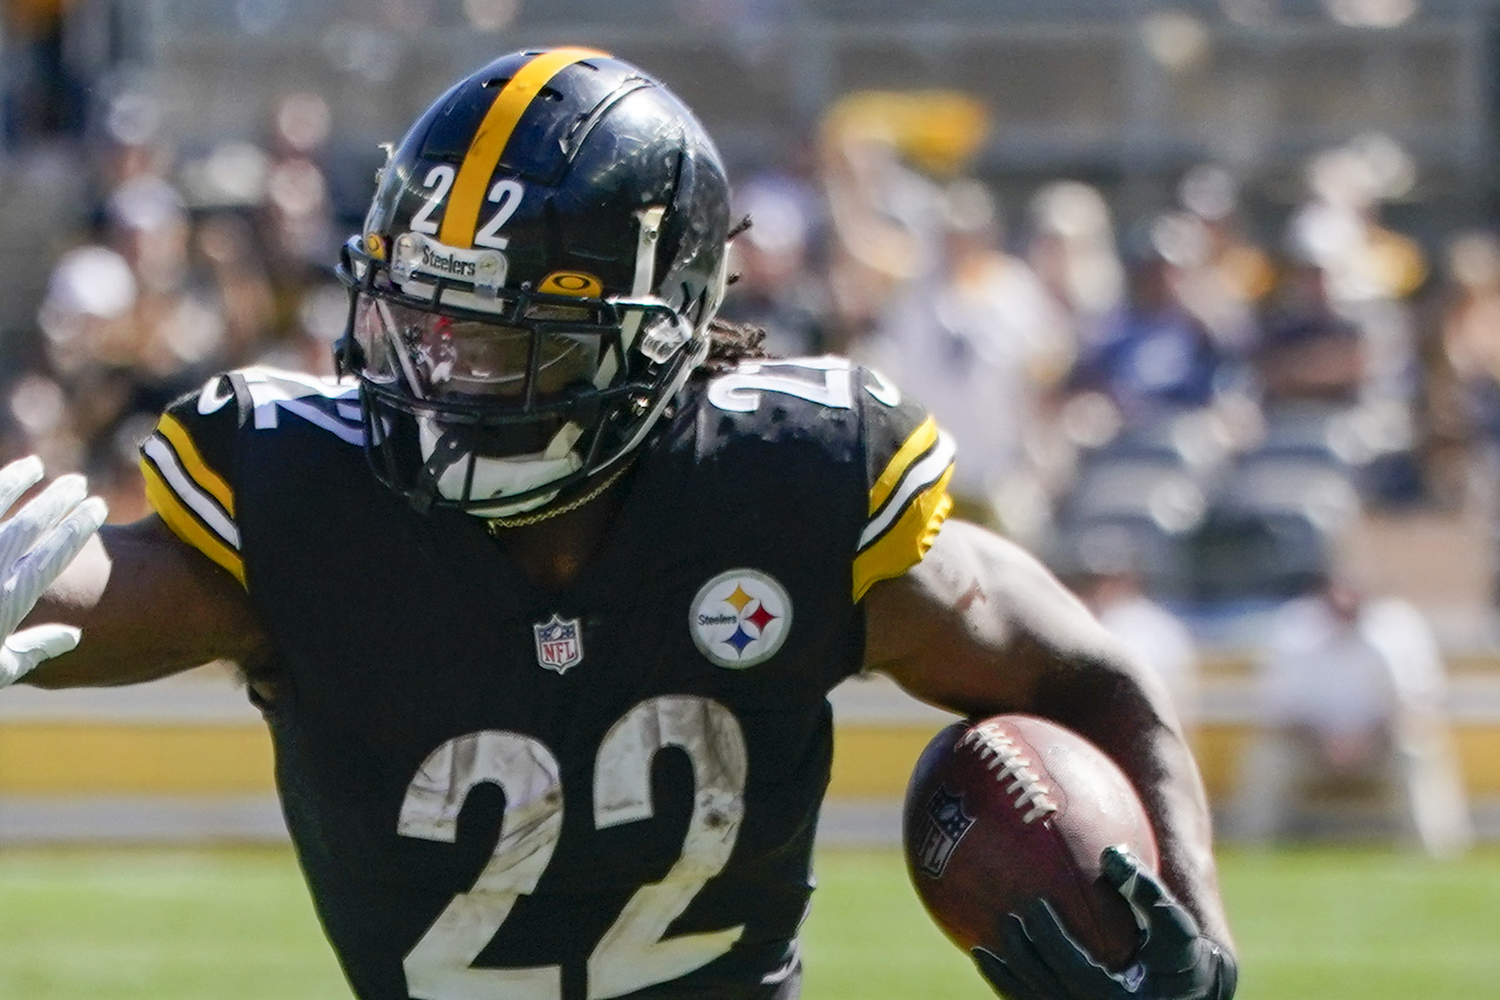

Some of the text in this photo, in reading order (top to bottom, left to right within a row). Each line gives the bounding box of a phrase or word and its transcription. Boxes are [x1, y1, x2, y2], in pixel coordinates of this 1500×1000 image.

[410, 165, 524, 250] 22
[422, 244, 476, 277] Steelers
[698, 613, 737, 627] Steelers
[543, 641, 576, 664] NFL
